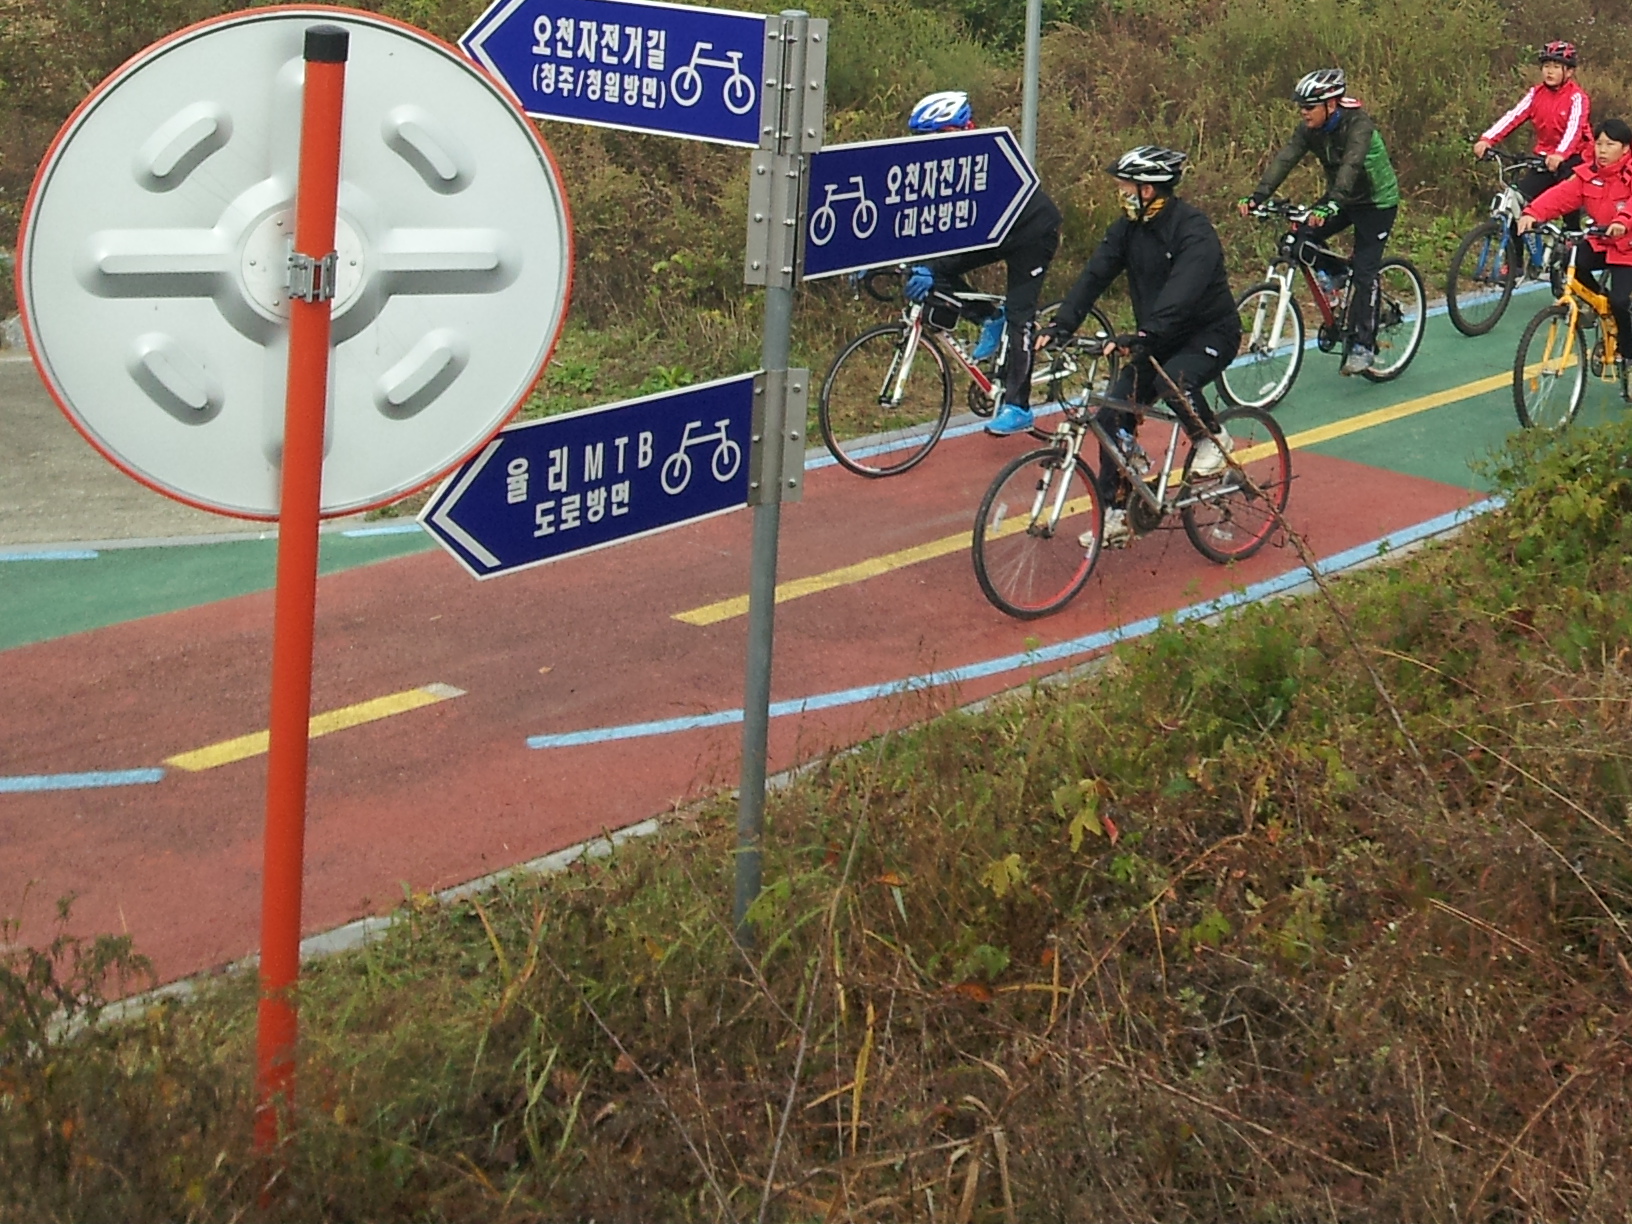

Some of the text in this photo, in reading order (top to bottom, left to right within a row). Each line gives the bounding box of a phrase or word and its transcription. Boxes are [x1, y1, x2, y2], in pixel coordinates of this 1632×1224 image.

[532, 14, 666, 71] 오천자전거길
[532, 62, 666, 109] (청주/청원방면)
[885, 153, 989, 205] 오천자전거길
[894, 198, 977, 238] (괴산방면)
[533, 480, 630, 538] 도로방면
